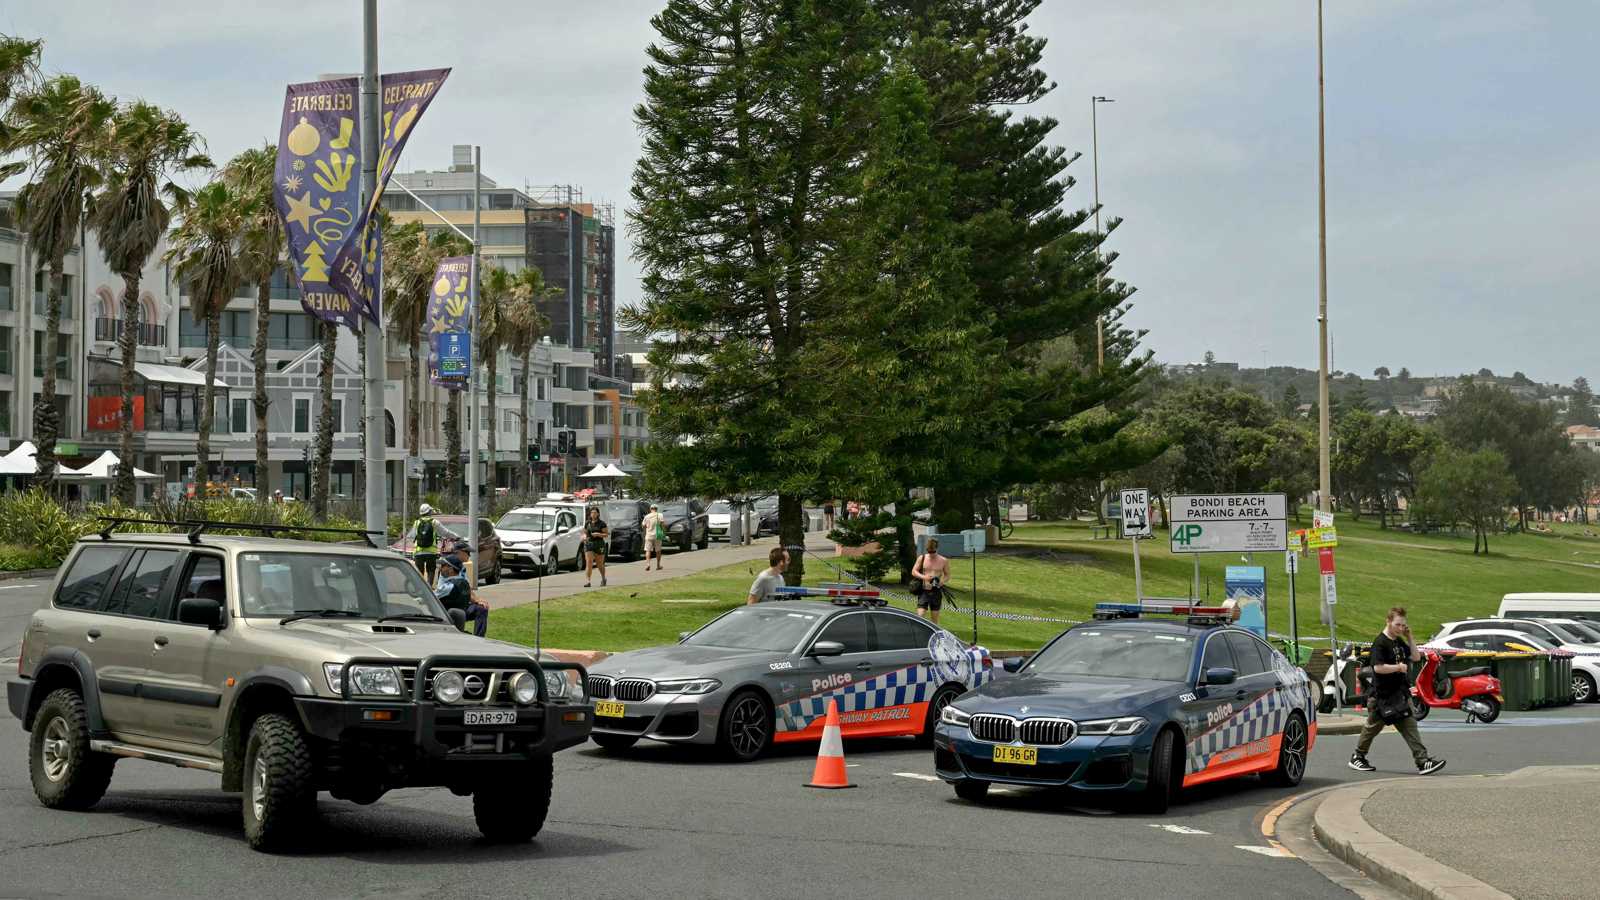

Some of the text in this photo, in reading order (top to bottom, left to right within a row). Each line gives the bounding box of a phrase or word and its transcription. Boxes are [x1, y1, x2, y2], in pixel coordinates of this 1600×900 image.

[451, 346, 458, 355] P
[1125, 493, 1144, 504] ONE
[1190, 497, 1265, 507] BONDI BEACH
[1125, 507, 1146, 518] WAY
[1187, 508, 1269, 517] PARKING AREA
[1172, 524, 1202, 545] 4P
[811, 672, 852, 692] Police
[1206, 702, 1233, 727] Police
[1010, 748, 1020, 760] 96
[1023, 749, 1035, 761] GR
